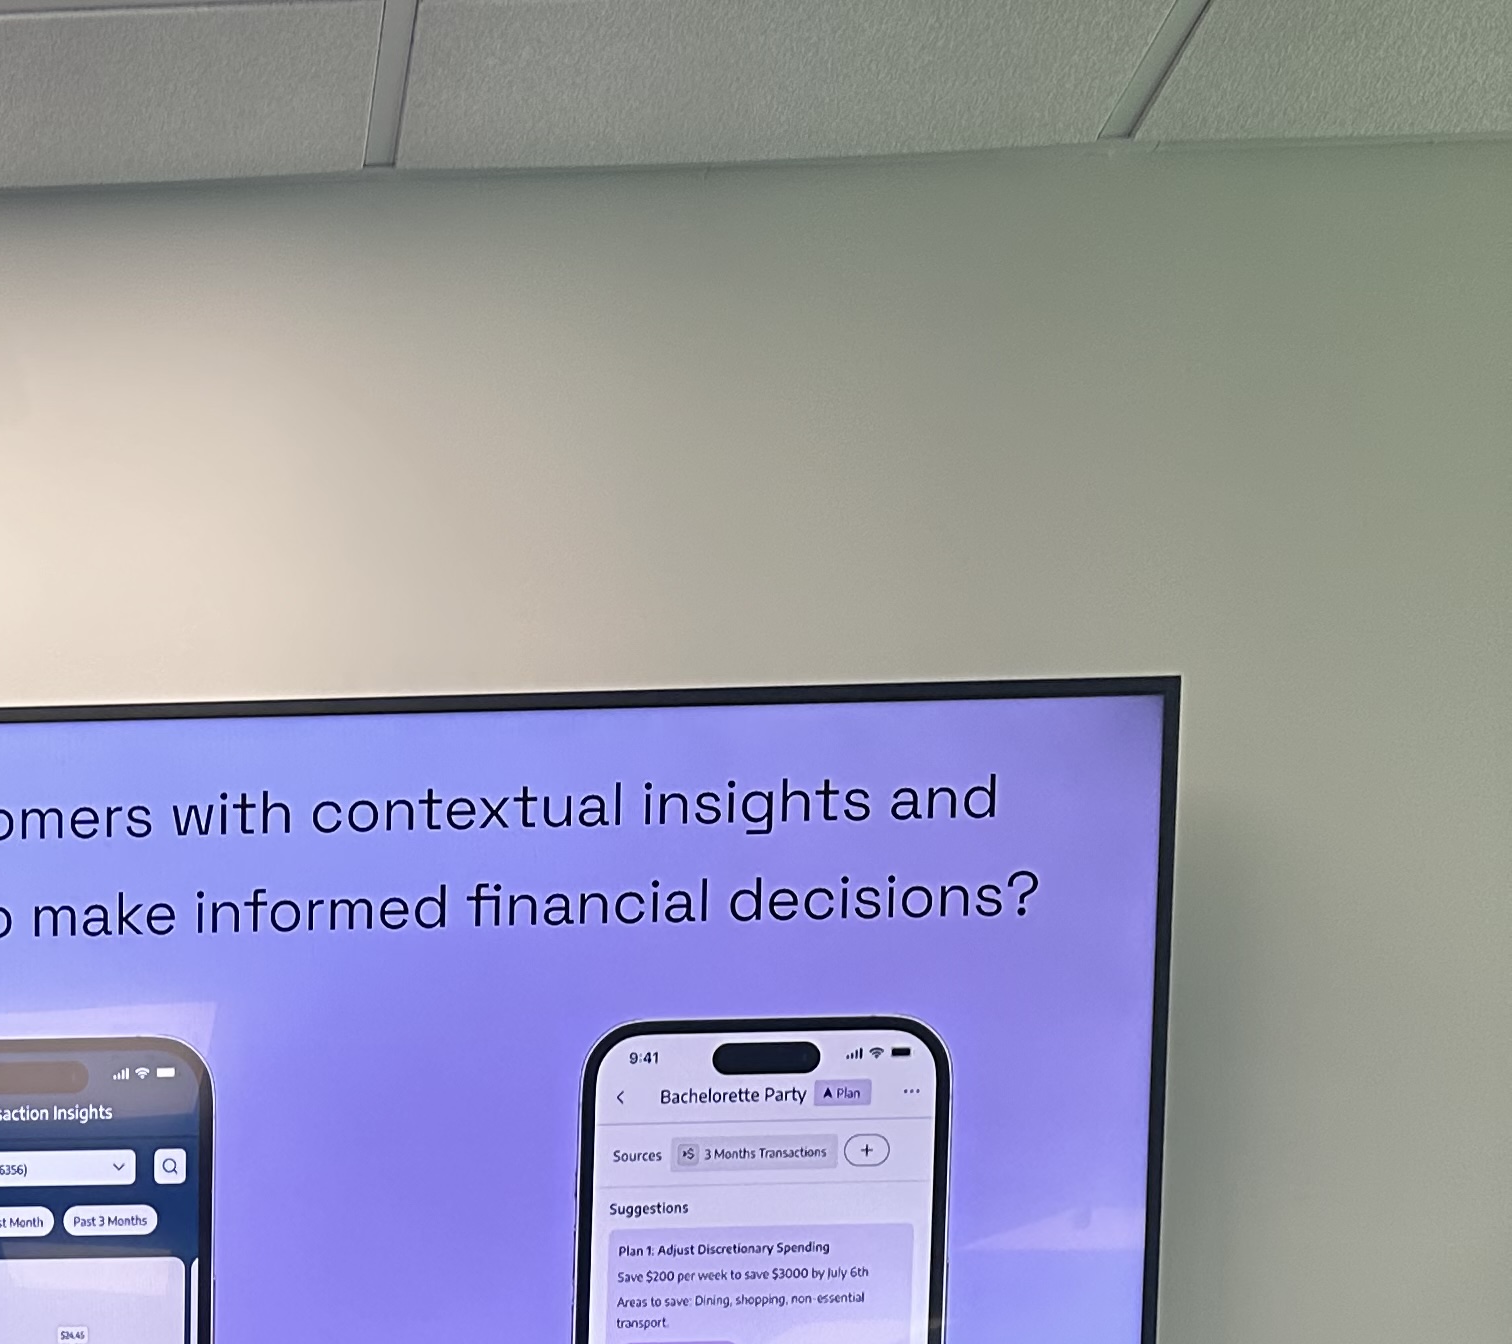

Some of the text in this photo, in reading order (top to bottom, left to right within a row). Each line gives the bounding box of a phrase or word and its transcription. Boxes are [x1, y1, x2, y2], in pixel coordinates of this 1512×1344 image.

[172, 789, 290, 836] with
[312, 781, 621, 834] contextual
[644, 777, 870, 835] insights
[890, 772, 996, 821] and
[33, 891, 176, 937] make
[196, 883, 446, 934] informed
[465, 877, 708, 927] financial
[729, 869, 1039, 922] decisions?
[629, 1051, 658, 1064] 9:41
[660, 1086, 807, 1105] Bachelorette Party
[836, 1086, 860, 1098] Plan
[53, 1103, 112, 1122] Insights
[613, 1149, 662, 1162] Sources
[704, 1146, 826, 1160] 3 Months Transactions
[609, 1201, 688, 1218] Suggestions
[9, 1216, 43, 1228] Month
[73, 1214, 147, 1227] Past 3 Months
[618, 1244, 643, 1256] Plan
[657, 1244, 694, 1257] Adjust
[697, 1243, 774, 1256] Discretionary
[776, 1240, 829, 1255] Spending
[617, 1271, 643, 1283] Save
[645, 1269, 674, 1283] $200
[677, 1272, 695, 1284] per
[697, 1268, 727, 1280] week
[730, 1269, 742, 1280] to
[744, 1270, 769, 1280] save
[771, 1267, 808, 1280] $3000
[811, 1266, 825, 1280] by
[849, 1266, 869, 1278] 6th
